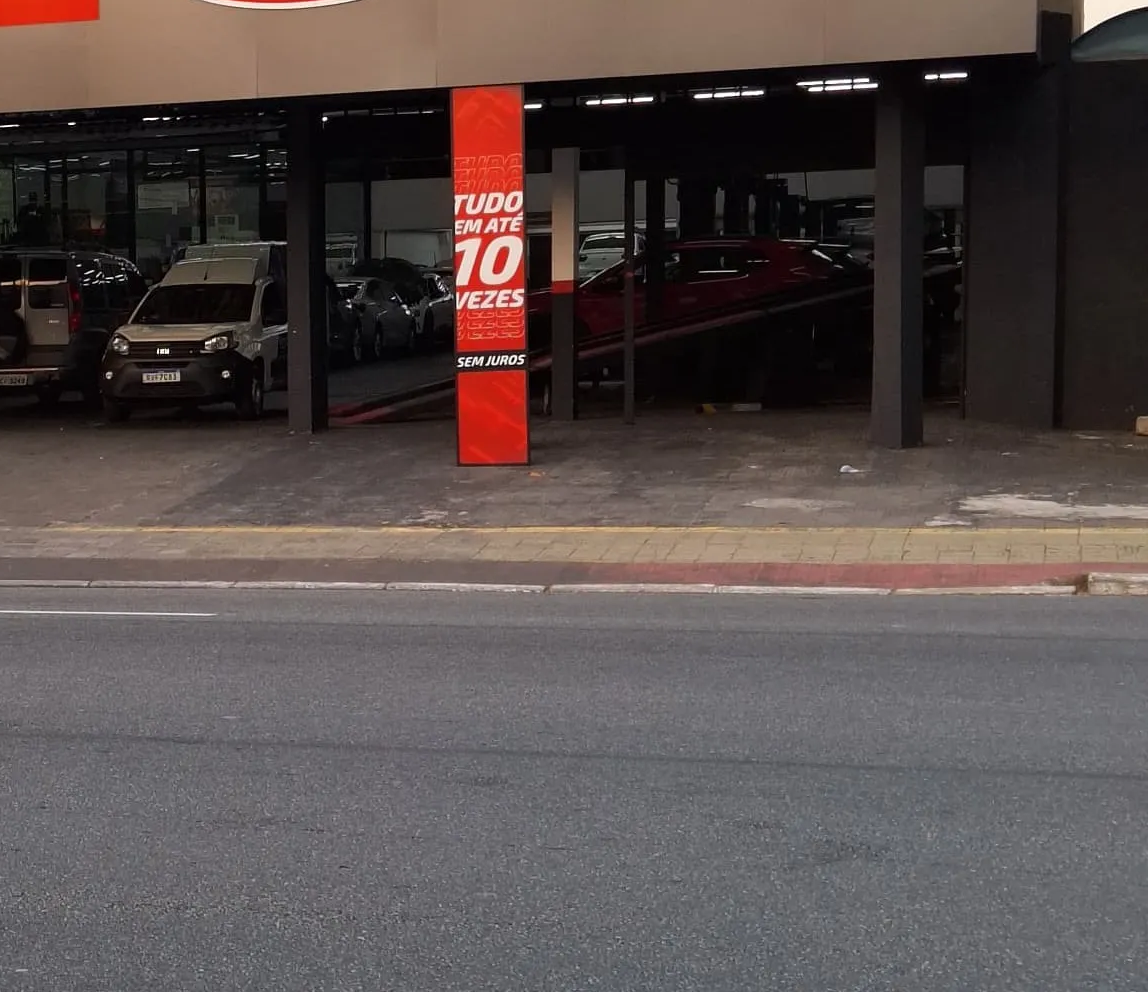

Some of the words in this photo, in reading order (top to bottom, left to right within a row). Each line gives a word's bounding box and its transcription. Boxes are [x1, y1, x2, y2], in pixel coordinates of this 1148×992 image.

[454, 190, 524, 216] TUDO
[455, 217, 483, 235] EM
[483, 212, 524, 234] ATÉ
[455, 235, 524, 287] 10
[456, 288, 525, 310] VEZES
[457, 356, 485, 368] SEM
[485, 354, 525, 367] JUROS
